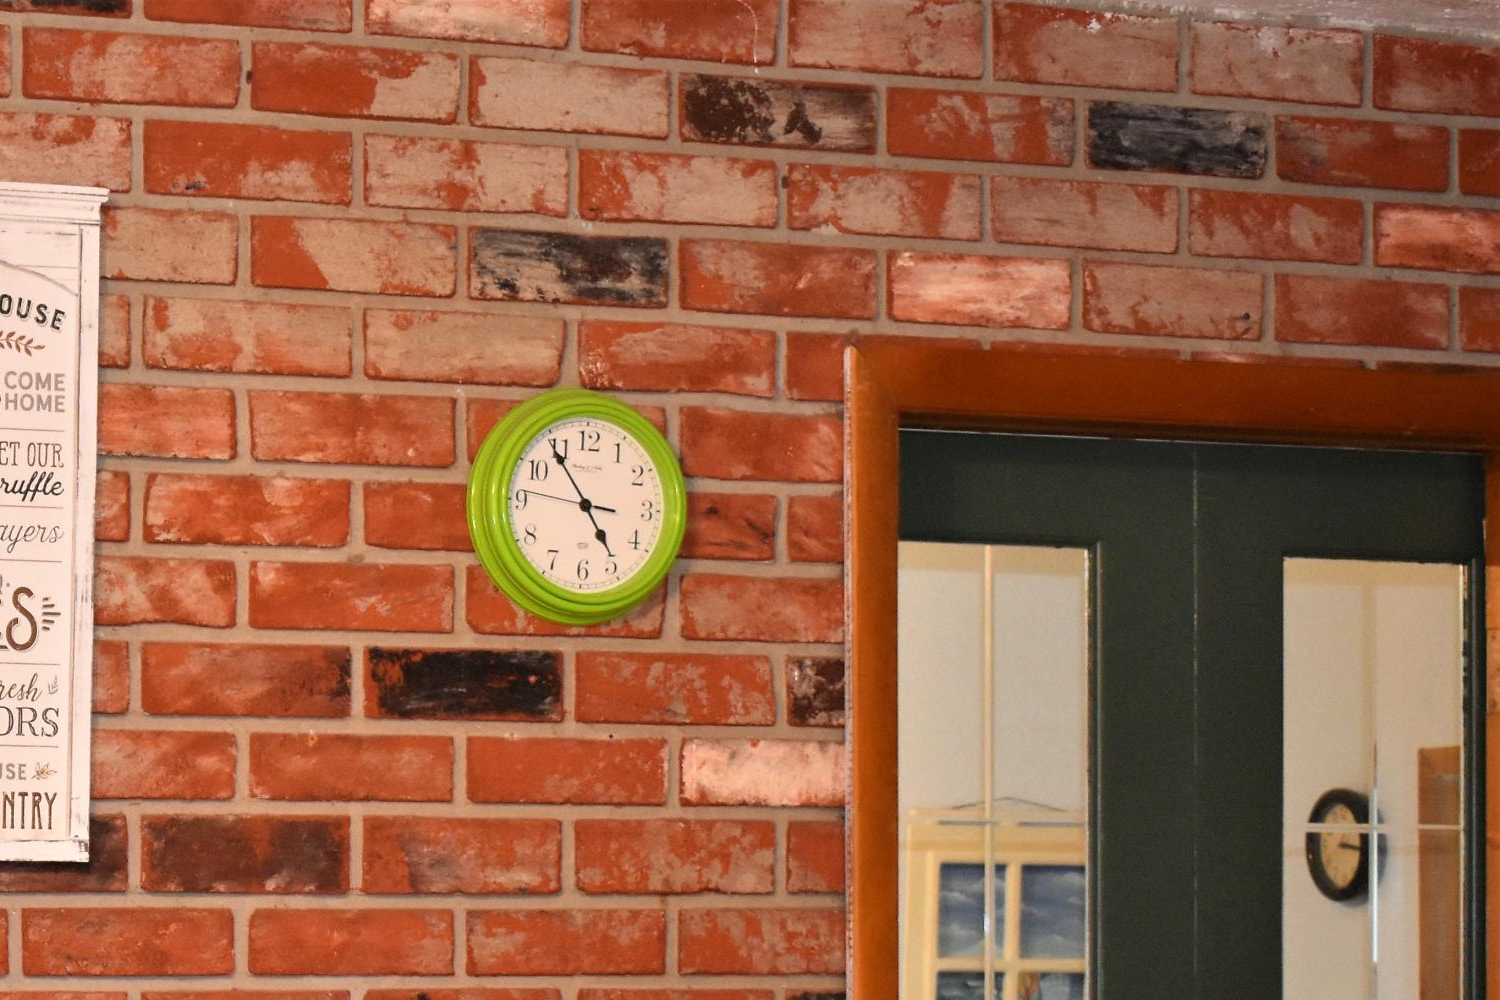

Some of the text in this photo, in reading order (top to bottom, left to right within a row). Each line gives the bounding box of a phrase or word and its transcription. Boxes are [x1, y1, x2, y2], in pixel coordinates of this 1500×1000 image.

[4, 371, 65, 392] COME
[4, 393, 65, 412] HOME
[578, 430, 600, 452] 12
[27, 443, 64, 468] OUR
[613, 443, 621, 463] 1
[529, 460, 549, 481] 10
[631, 465, 644, 486] 2
[0, 471, 64, 502] ruffle
[515, 490, 527, 510] 9
[640, 500, 653, 521] 3
[524, 524, 536, 545] 8
[628, 529, 640, 550] 4
[547, 550, 559, 570] 7
[577, 560, 589, 581] 6
[605, 554, 618, 575] 5
